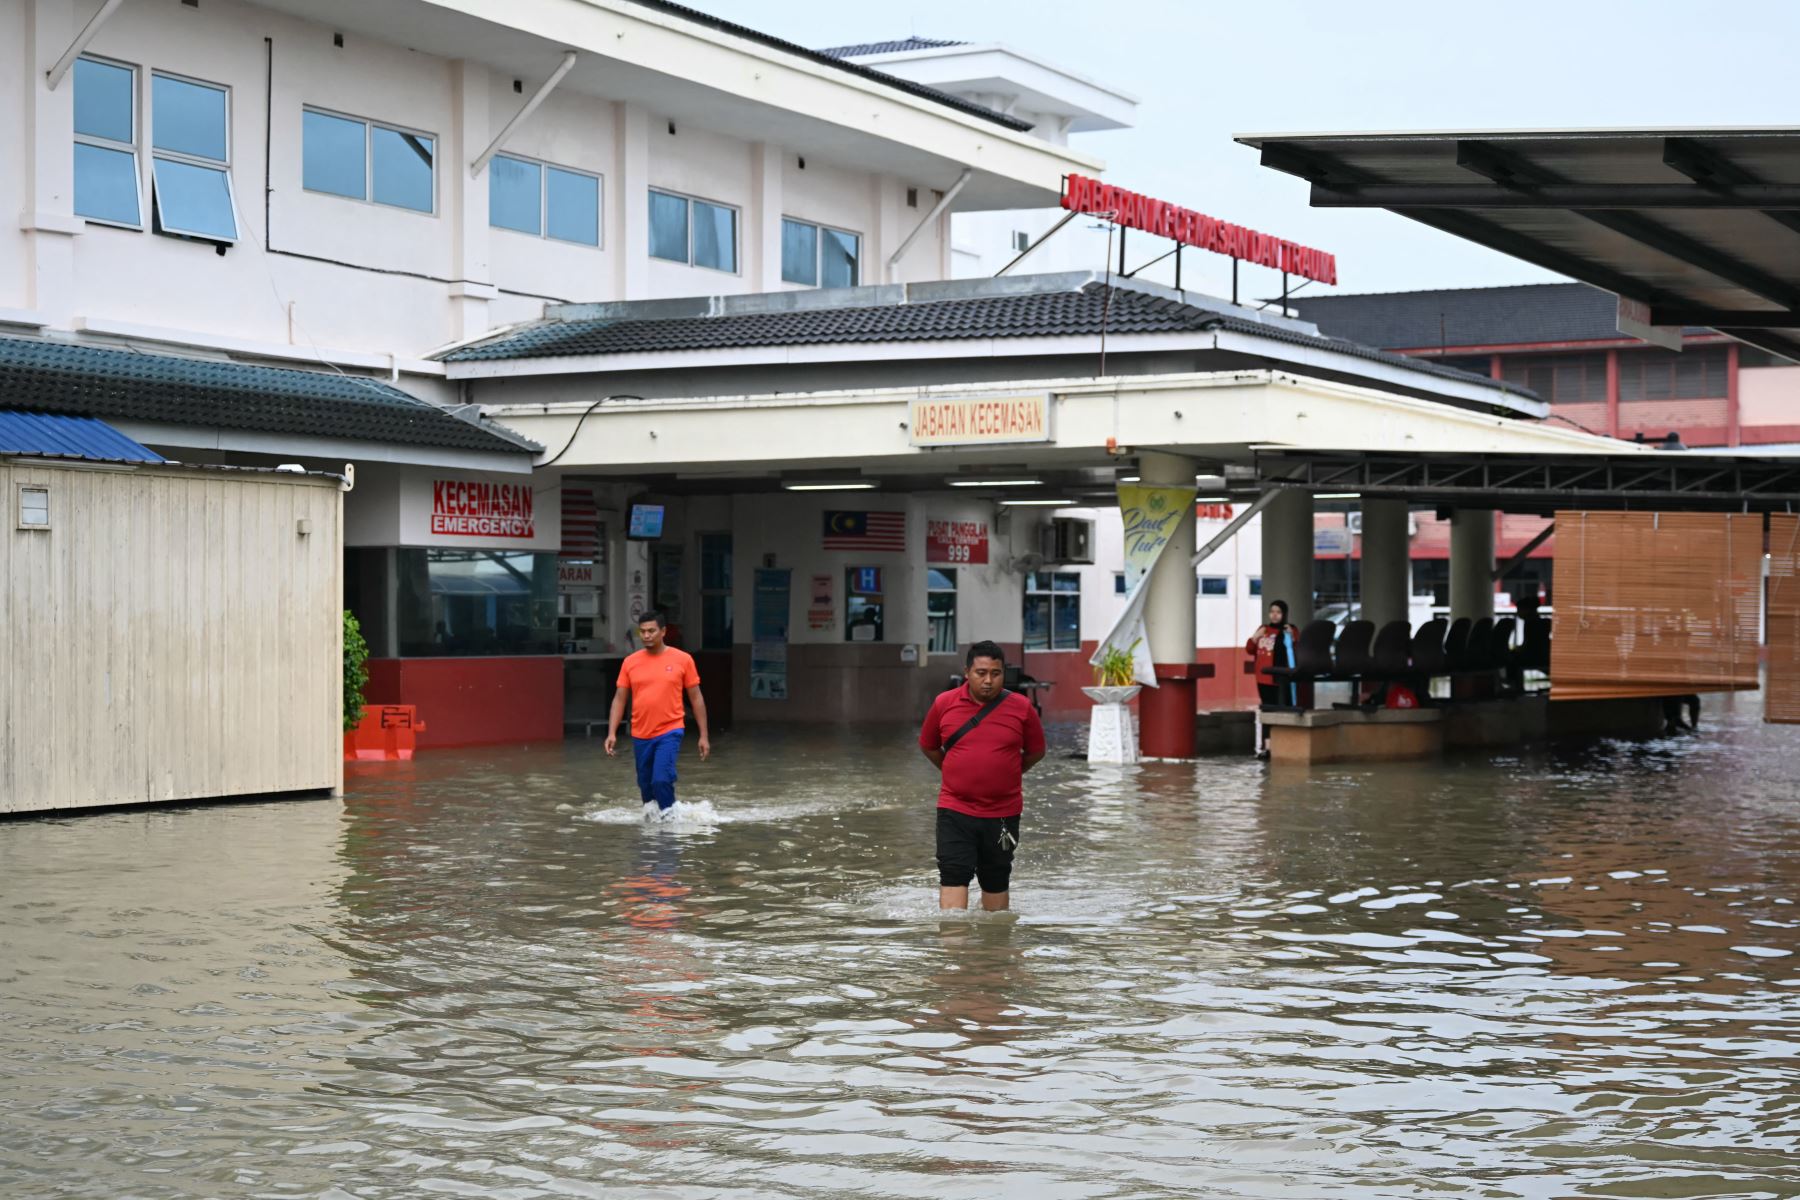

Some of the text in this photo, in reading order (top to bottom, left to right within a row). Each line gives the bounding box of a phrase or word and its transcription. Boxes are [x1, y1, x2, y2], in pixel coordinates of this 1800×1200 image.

[1061, 173, 1337, 286] JABATAN KECEMASAN DAN TRAUMA
[915, 400, 1041, 437] JABATAN KECEMASAN
[433, 479, 533, 518] KECEMASAN
[433, 516, 532, 535] EMERGENCY
[948, 545, 970, 562] 999
[861, 568, 875, 589] H
